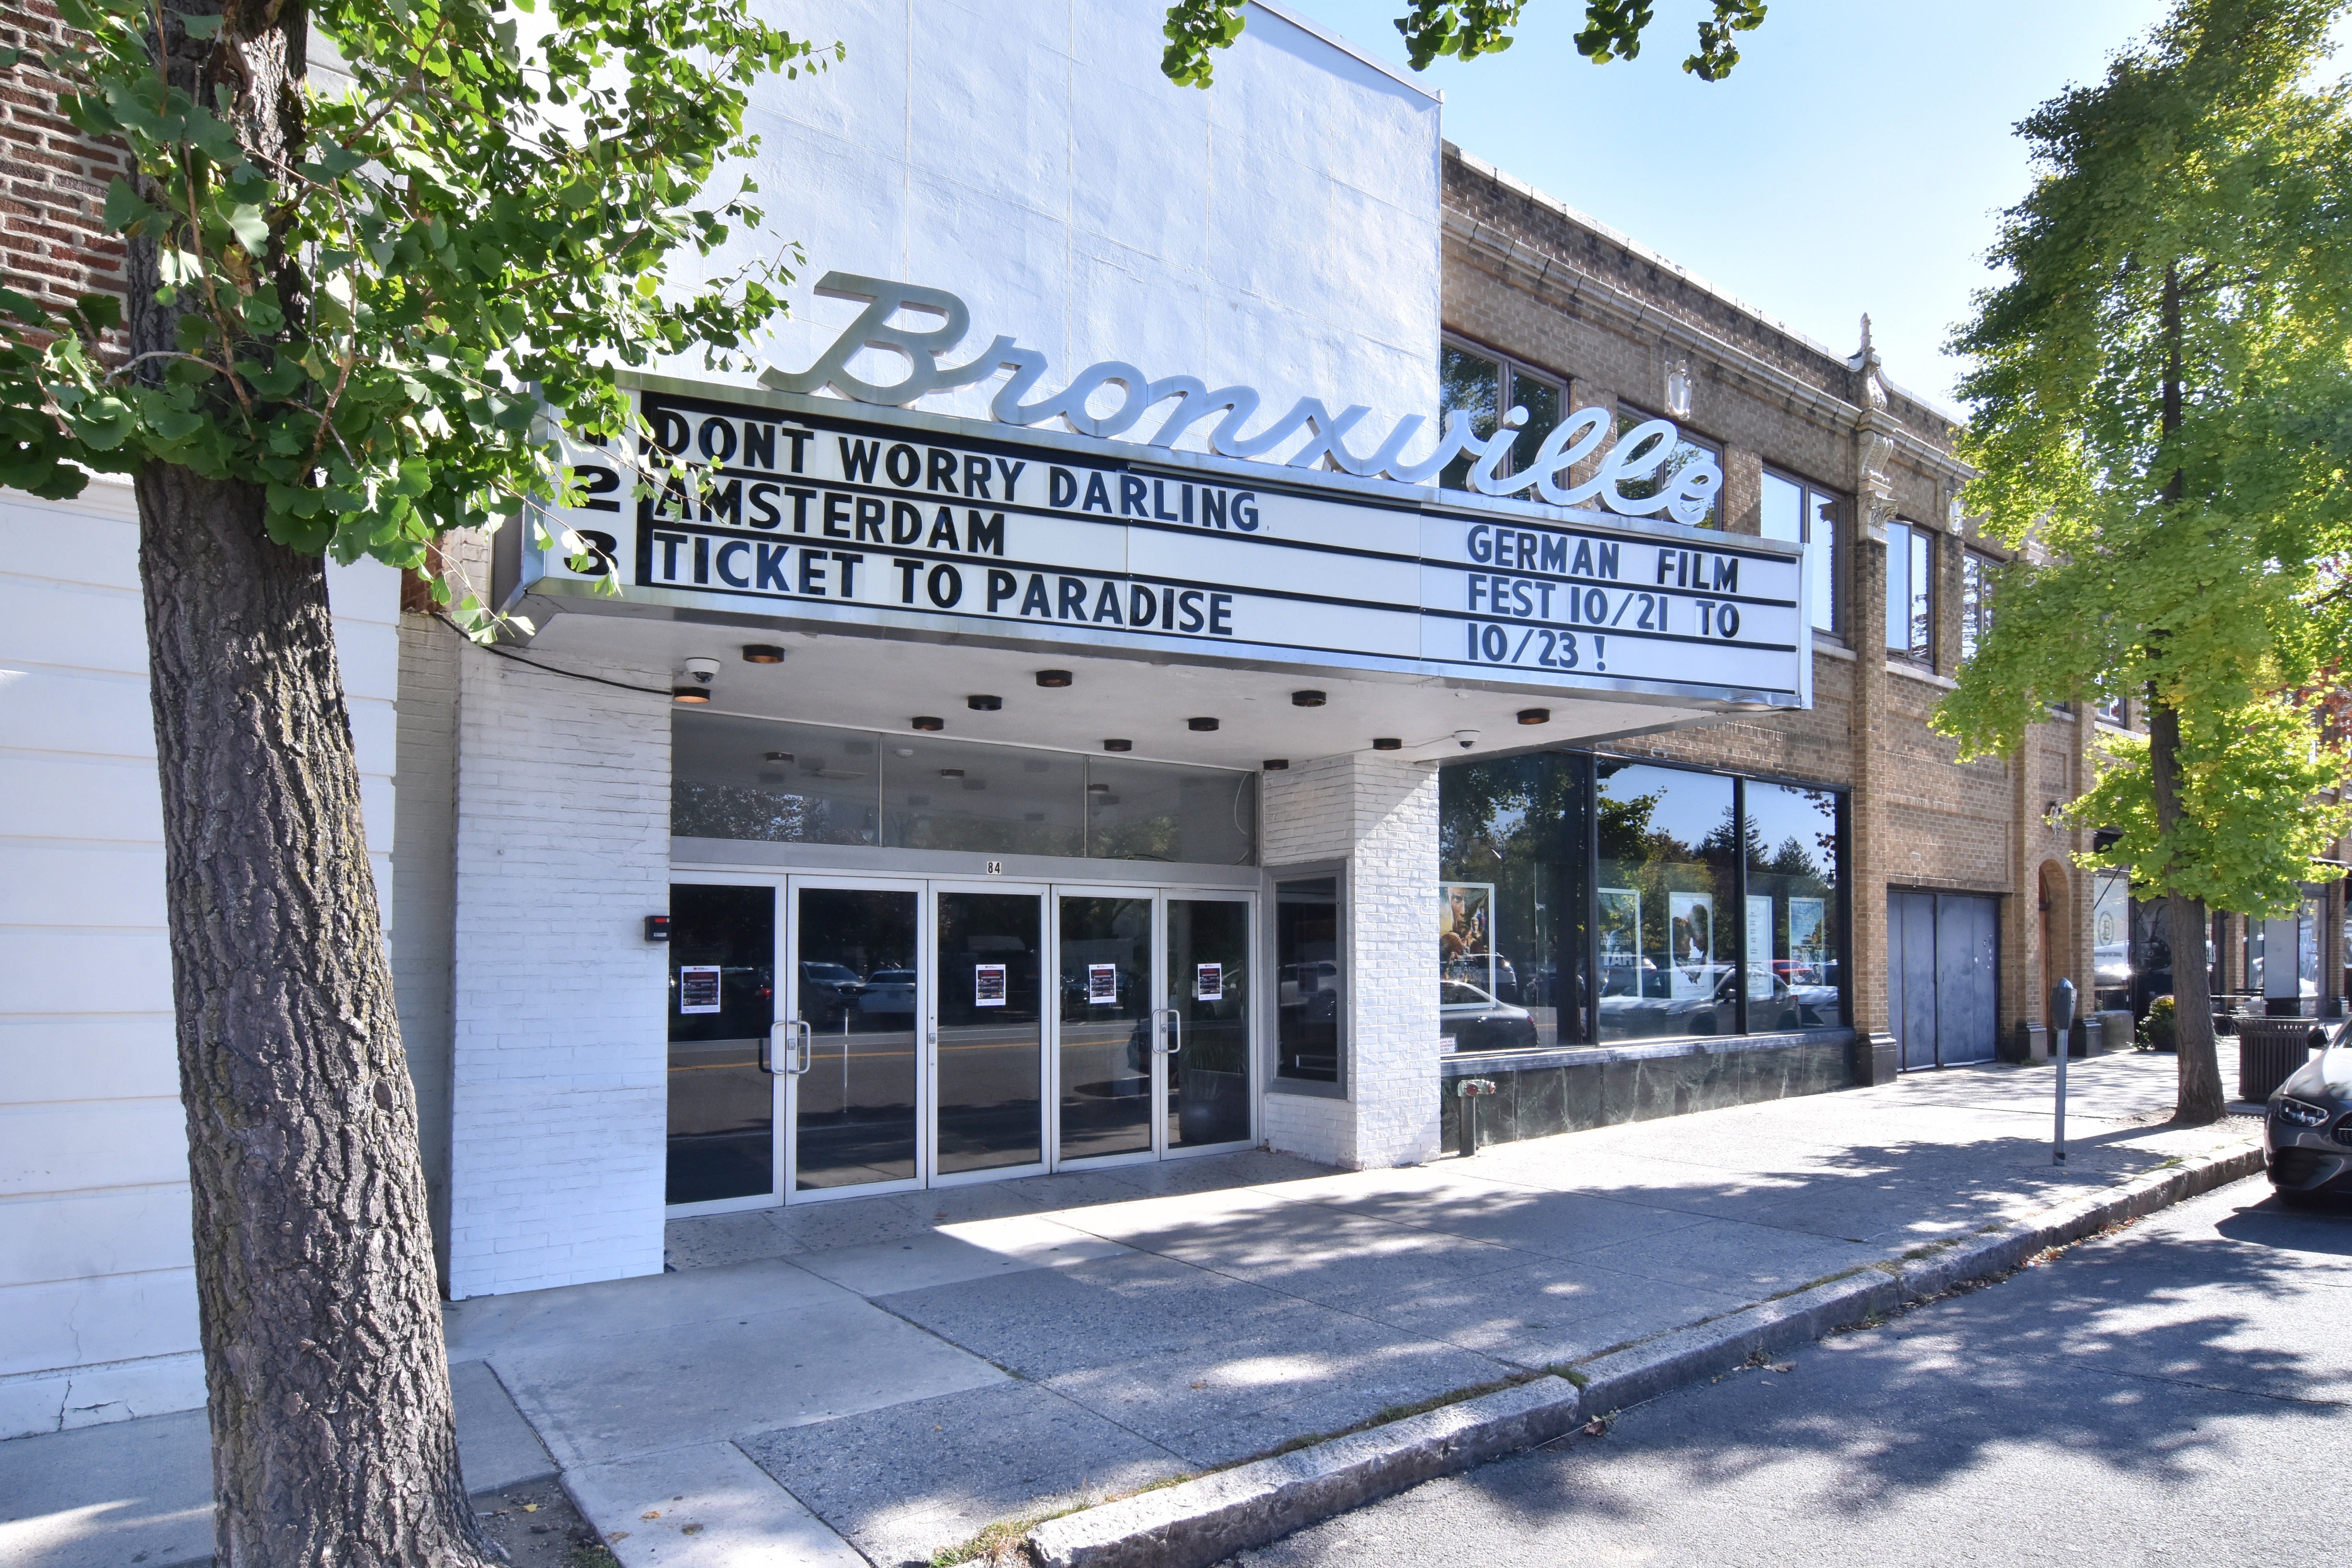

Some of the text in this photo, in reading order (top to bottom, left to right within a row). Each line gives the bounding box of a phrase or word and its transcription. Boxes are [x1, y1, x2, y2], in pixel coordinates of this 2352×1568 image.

[757, 271, 1722, 526] Bronxville
[572, 465, 620, 513] 2
[656, 410, 815, 474] DONT
[838, 436, 1026, 502] WORRY
[1049, 466, 1259, 532] DARLING
[654, 470, 1005, 556] AMSTERDAM
[563, 529, 619, 576] 3
[653, 532, 1232, 635] TICKET TO PARADISE
[1467, 524, 1739, 593] GERMAN FILM
[1468, 573, 1740, 639] FEST 10/21 TO
[988, 862, 1000, 874] 84
